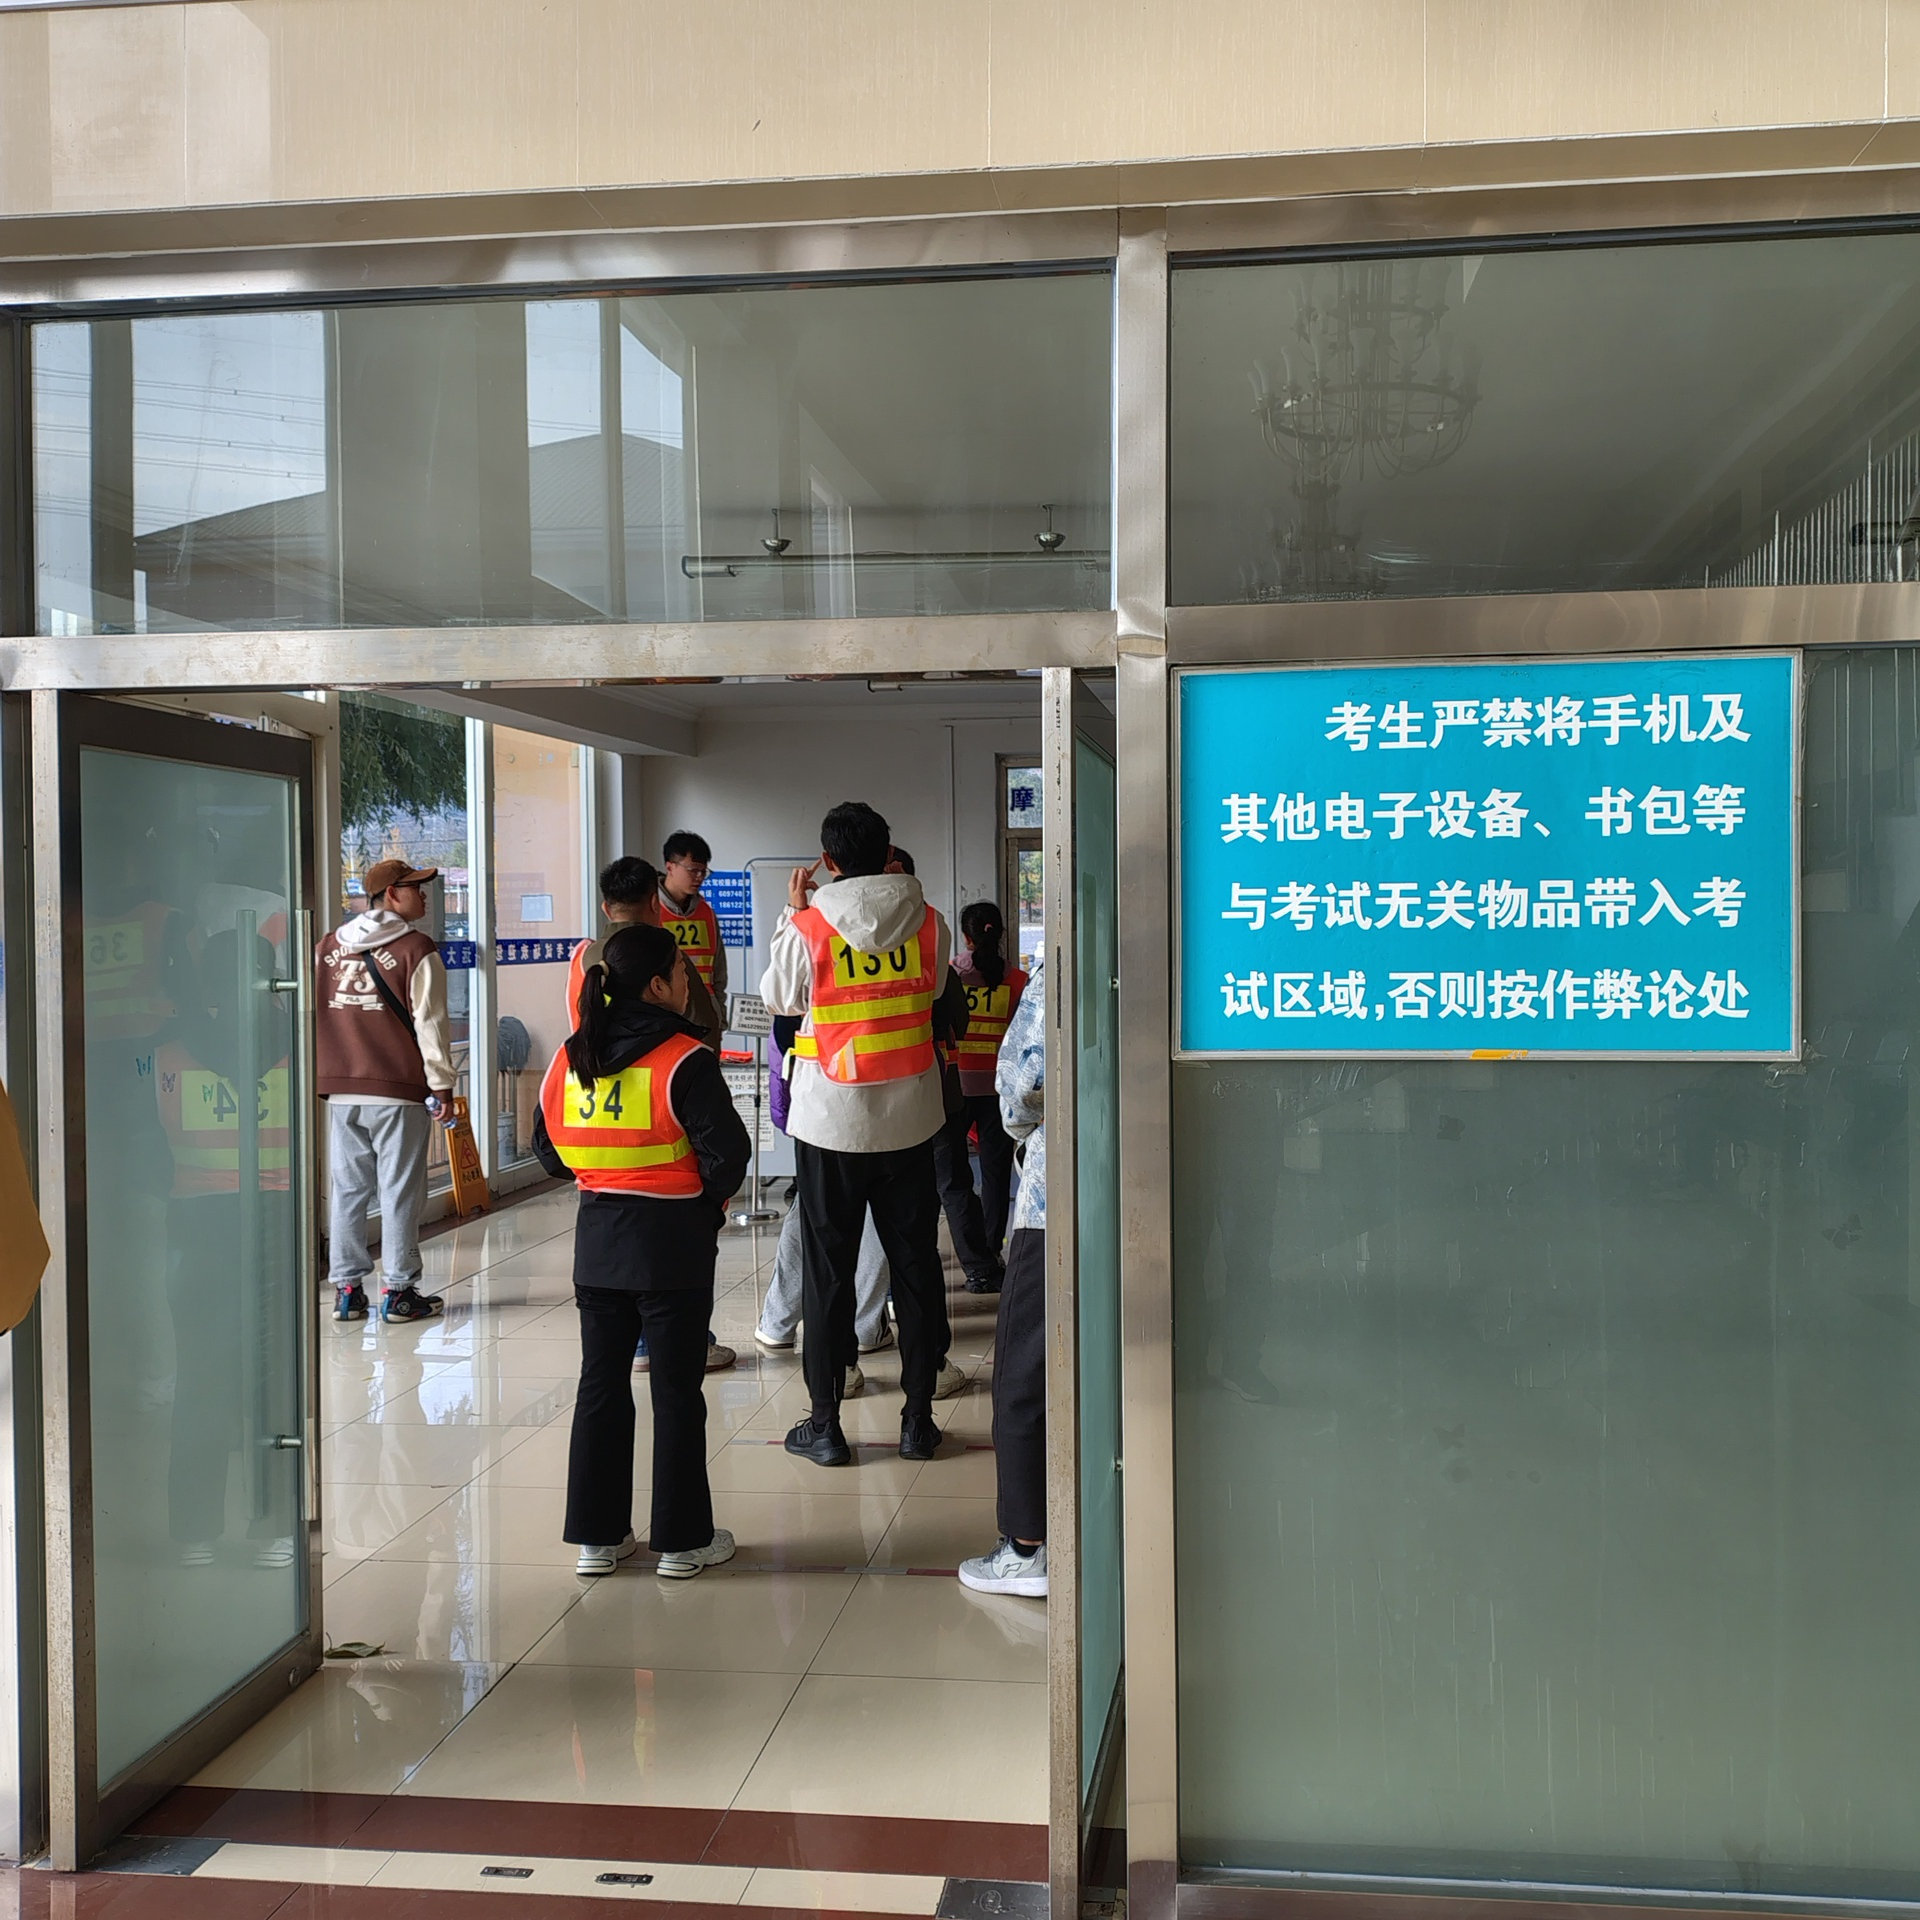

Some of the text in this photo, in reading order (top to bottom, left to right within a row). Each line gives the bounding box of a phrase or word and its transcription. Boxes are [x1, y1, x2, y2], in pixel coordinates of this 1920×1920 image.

[1325, 693, 1751, 751] 考生严禁将手机及
[1010, 786, 1035, 812] 摩
[1220, 783, 1746, 843] 其他电子设备、书包等
[1221, 876, 1746, 931] 与考试无关物品带入考
[675, 924, 700, 946] 22
[966, 986, 992, 1013] 51
[1220, 968, 1749, 1021] 试区域,否则按作弊论处
[579, 1080, 623, 1121] 34
